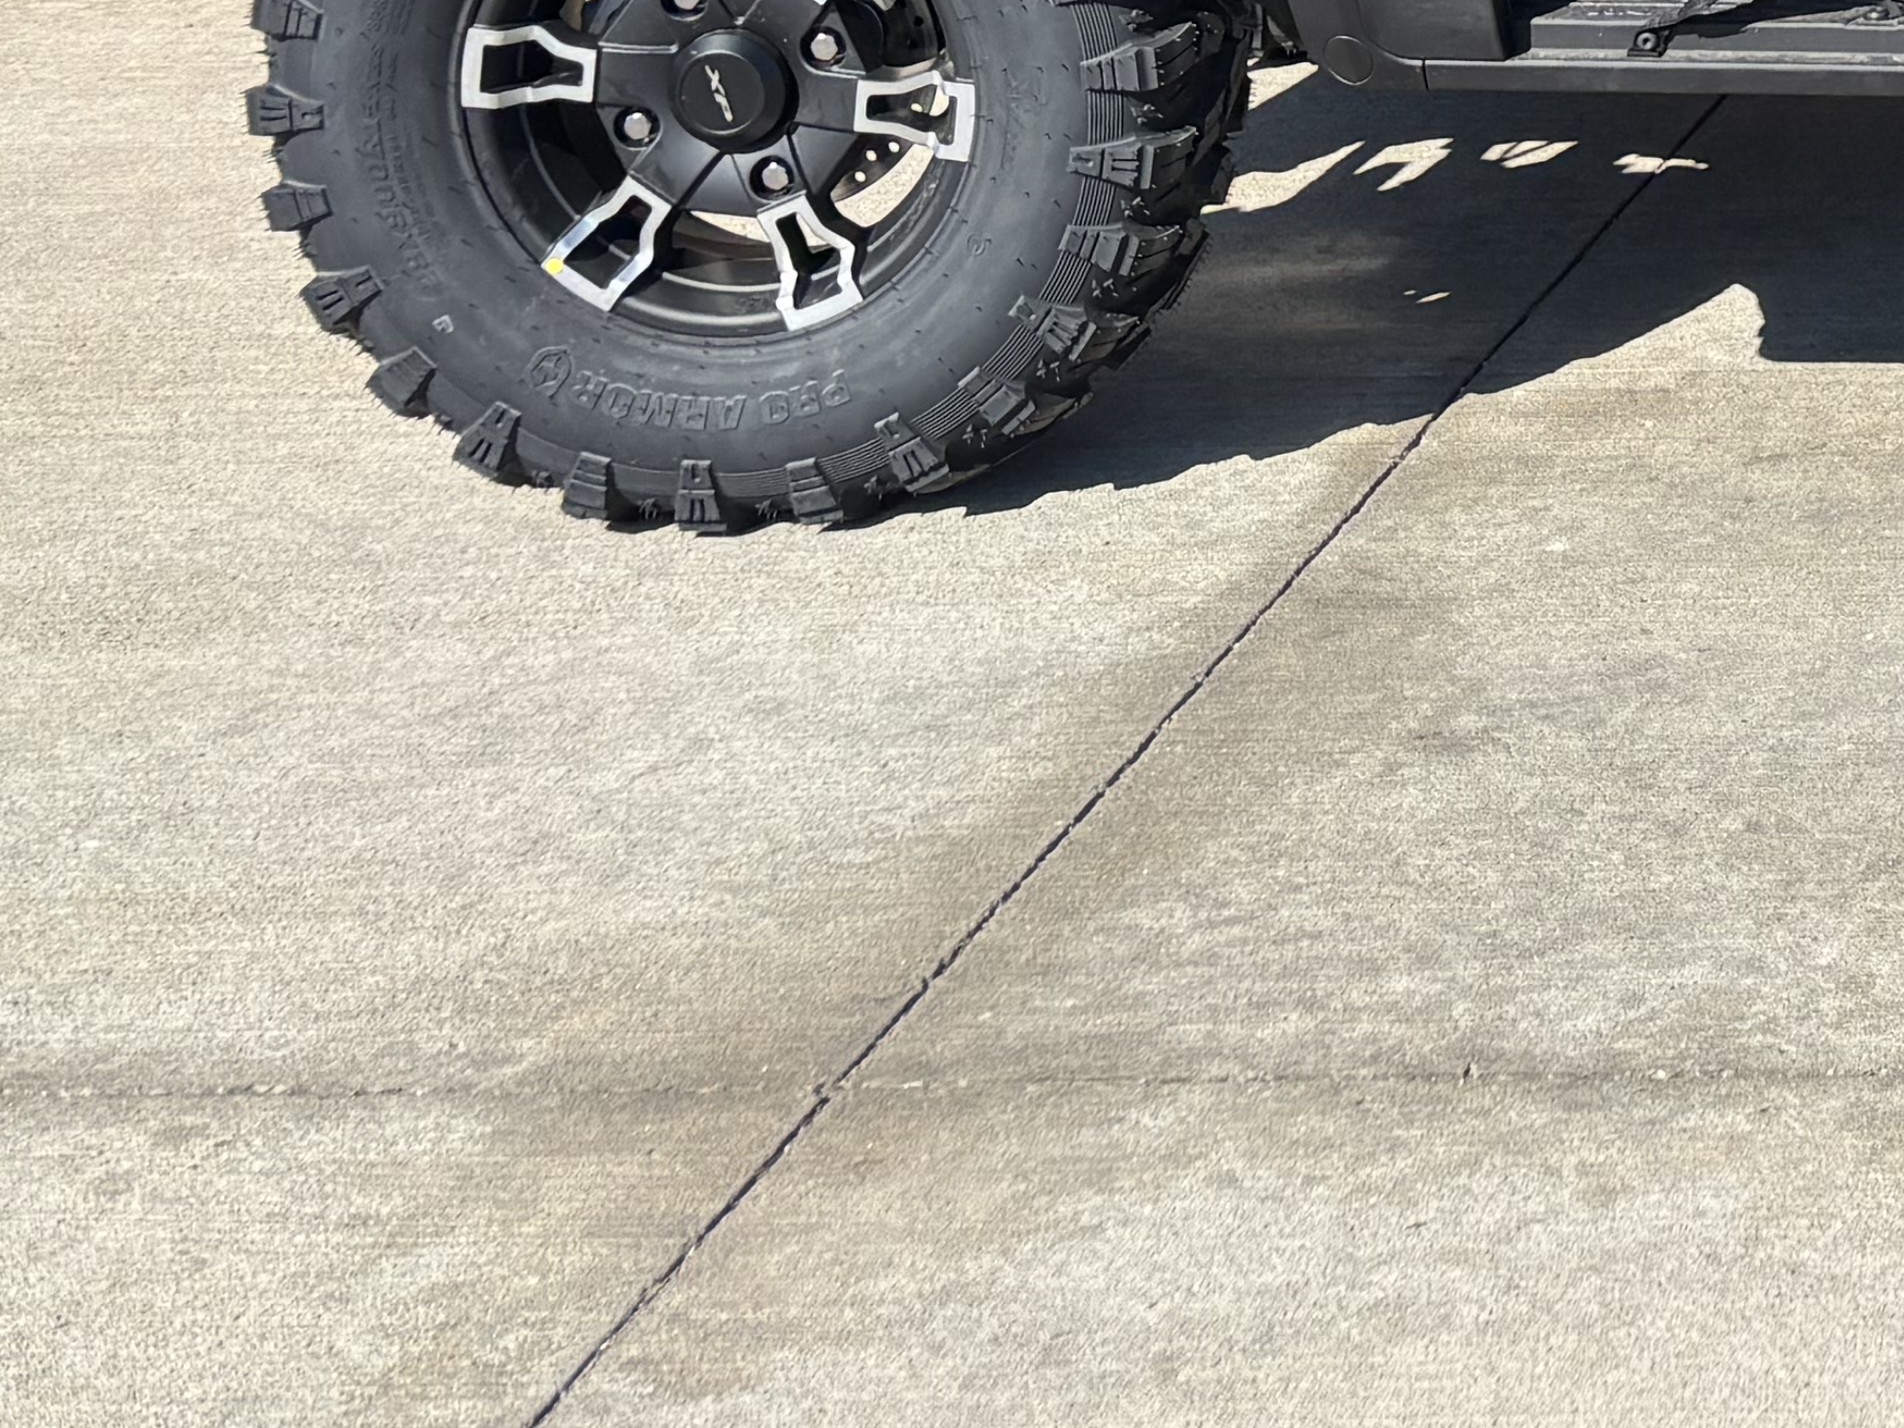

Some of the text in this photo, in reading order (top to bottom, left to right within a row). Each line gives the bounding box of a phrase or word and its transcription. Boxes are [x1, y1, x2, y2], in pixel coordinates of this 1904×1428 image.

[704, 64, 734, 123] XP
[570, 367, 852, 432] PRO ARMOR
